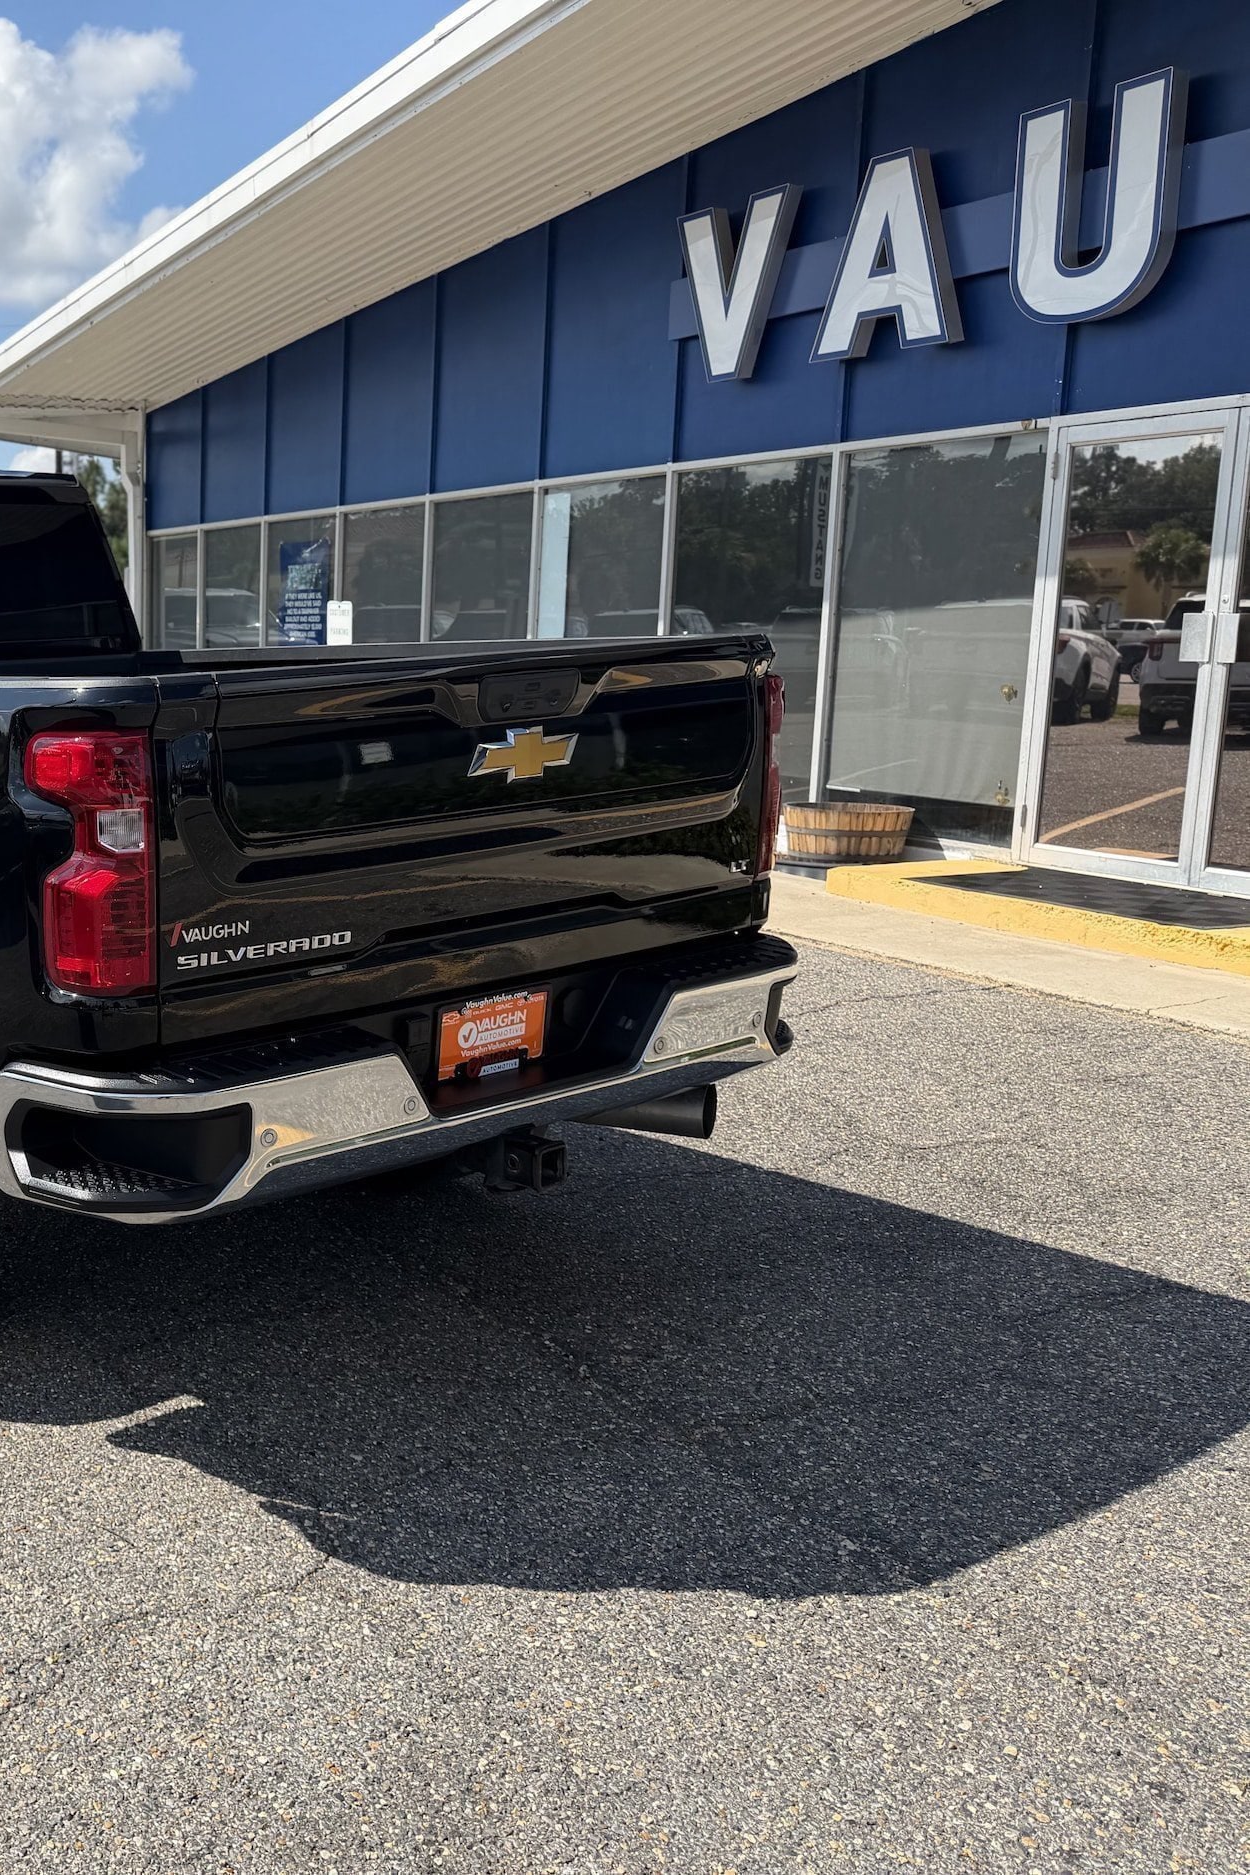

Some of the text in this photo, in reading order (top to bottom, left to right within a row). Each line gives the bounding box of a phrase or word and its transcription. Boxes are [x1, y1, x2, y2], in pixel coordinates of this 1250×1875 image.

[730, 859, 750, 873] LT
[182, 920, 250, 944] VAUGHN
[177, 930, 352, 970] SILVERADO
[465, 991, 528, 1010] VaughnValue.com
[495, 1002, 514, 1011] GMC
[476, 1009, 527, 1032] VAUGHN
[478, 1026, 524, 1042] AUTOMOTIVE
[461, 1038, 522, 1057] VaughnValue.com
[482, 1060, 518, 1074] AUTOMOTIVE
